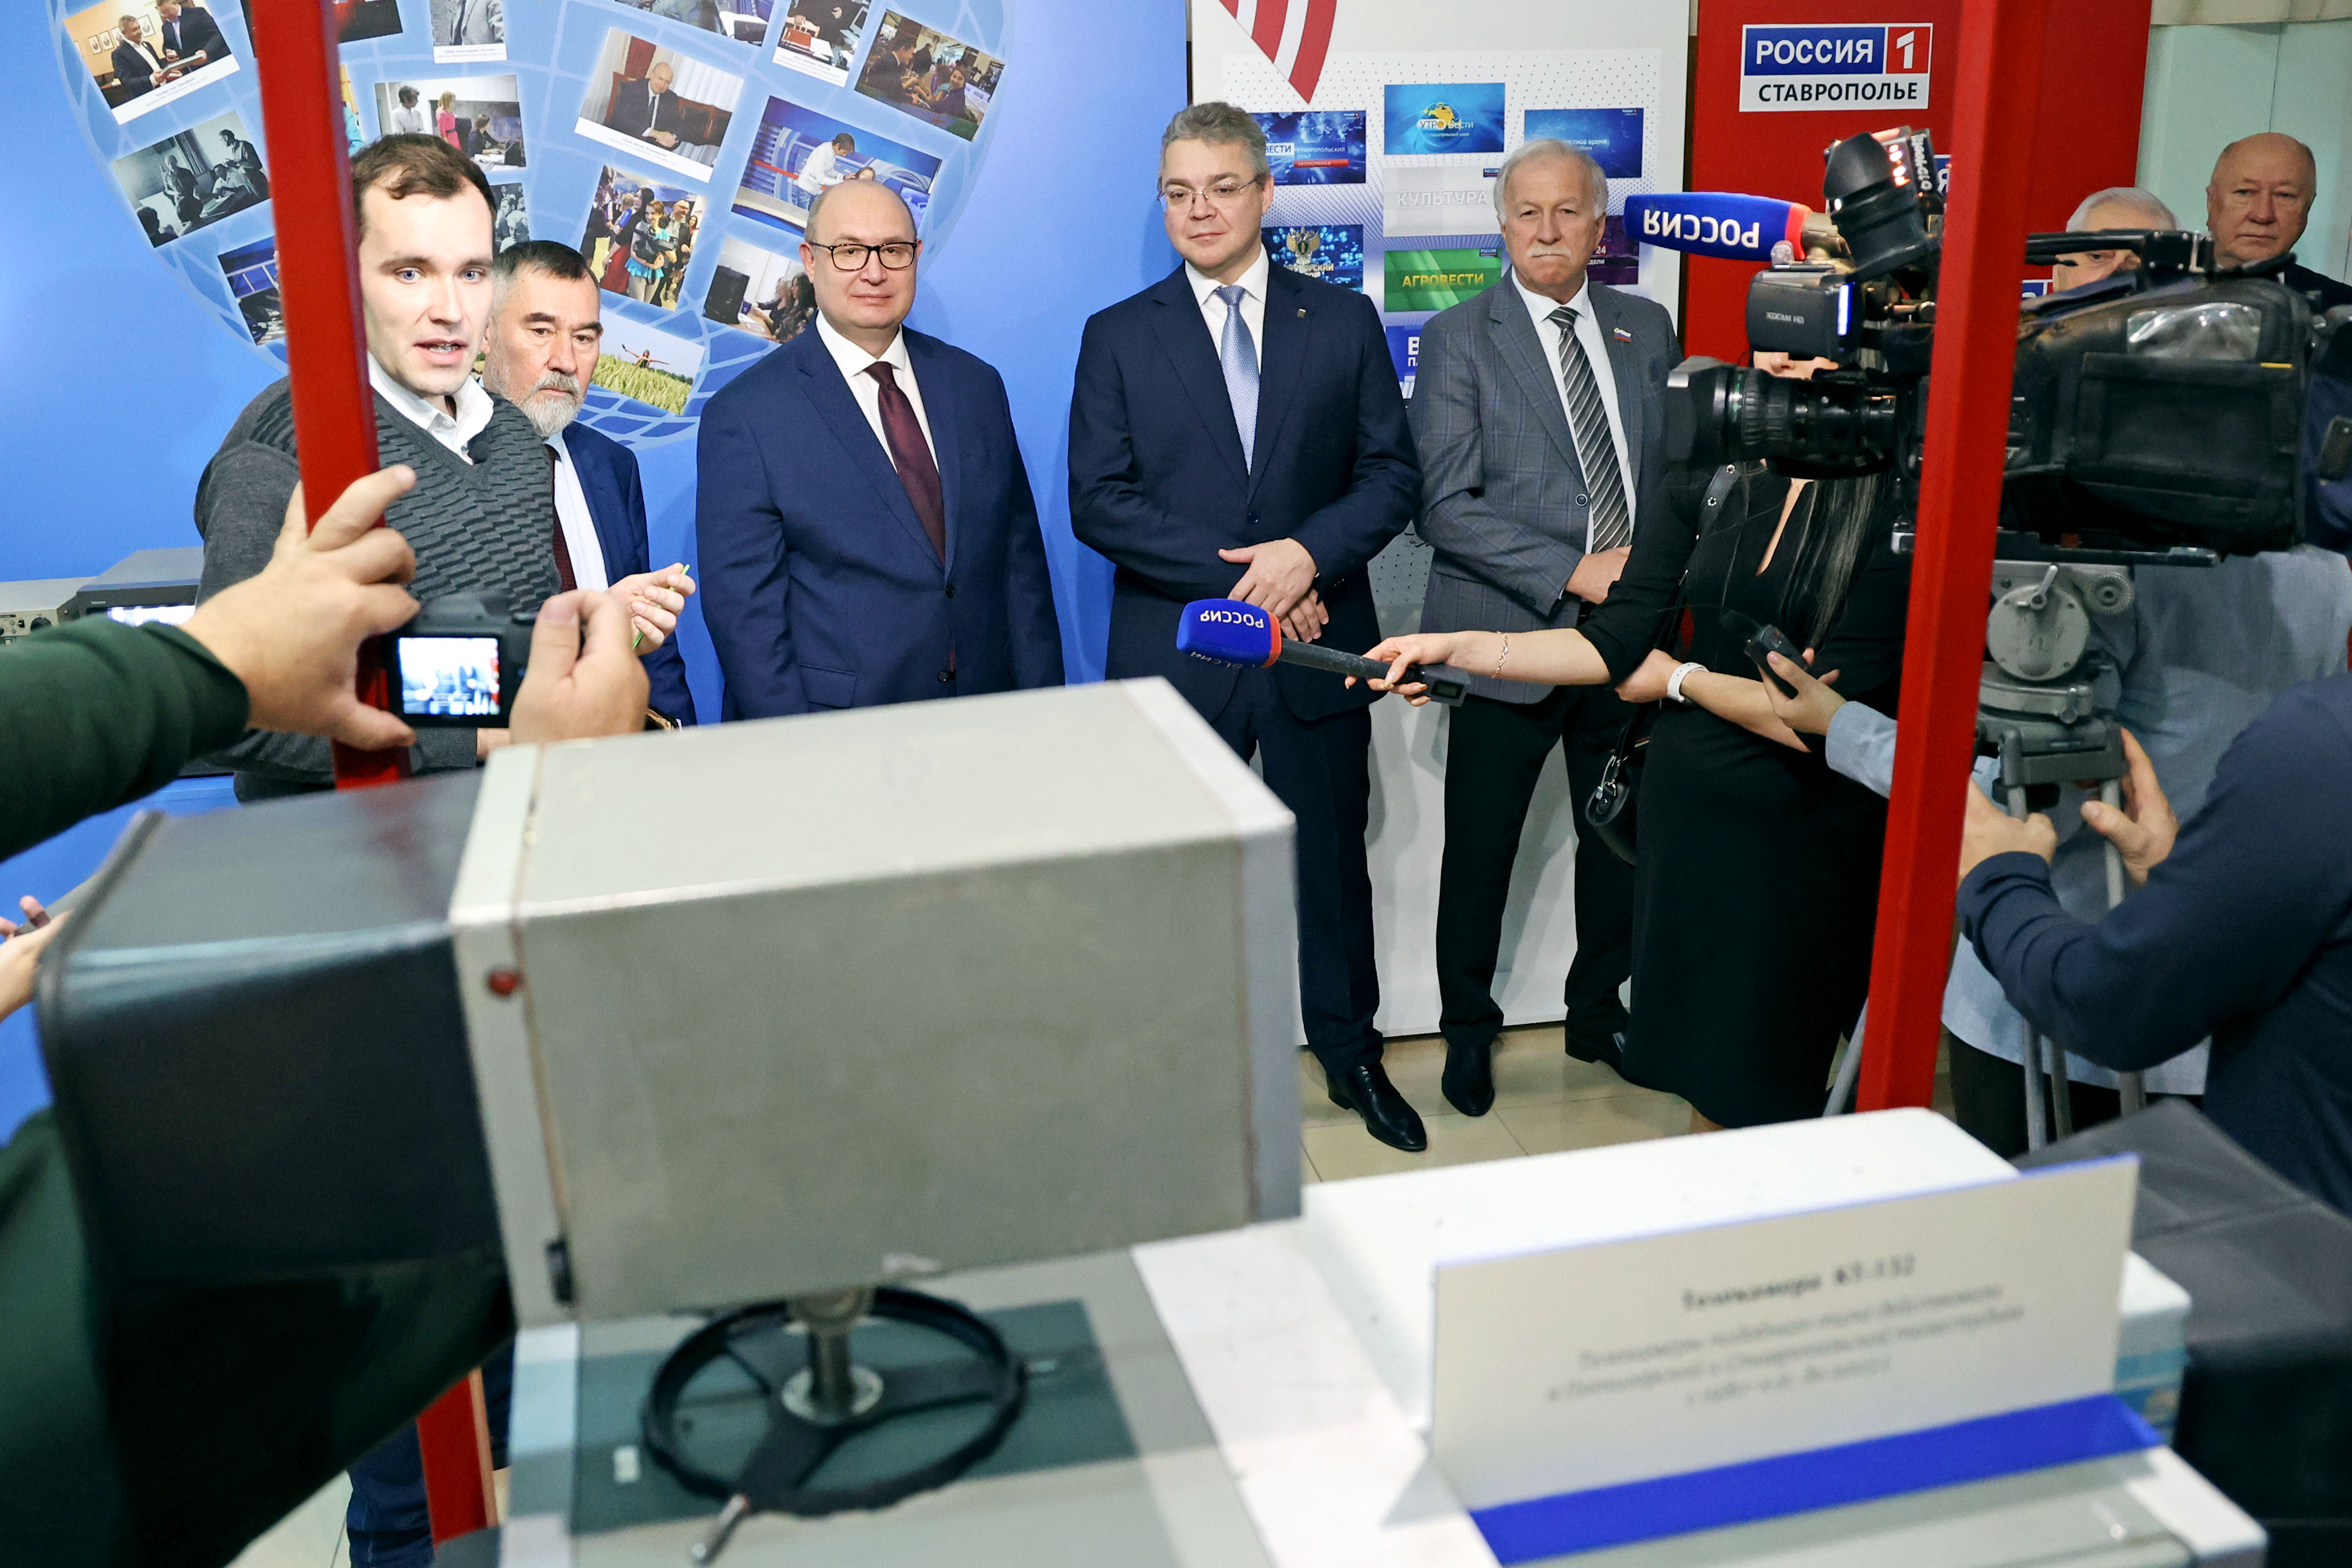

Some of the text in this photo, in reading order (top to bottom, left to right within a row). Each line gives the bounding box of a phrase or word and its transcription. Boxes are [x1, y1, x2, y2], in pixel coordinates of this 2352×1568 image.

[1756, 30, 1915, 69] РОССИЯ 1
[1758, 82, 1917, 102] СТАВРОПОЛЬЕ
[1397, 191, 1487, 206] КУЛЬТУРА
[1644, 209, 1759, 249] РОССИЯ
[1402, 274, 1484, 287] АГРОВЕСТИ
[1200, 610, 1264, 628] РОССИЯ
